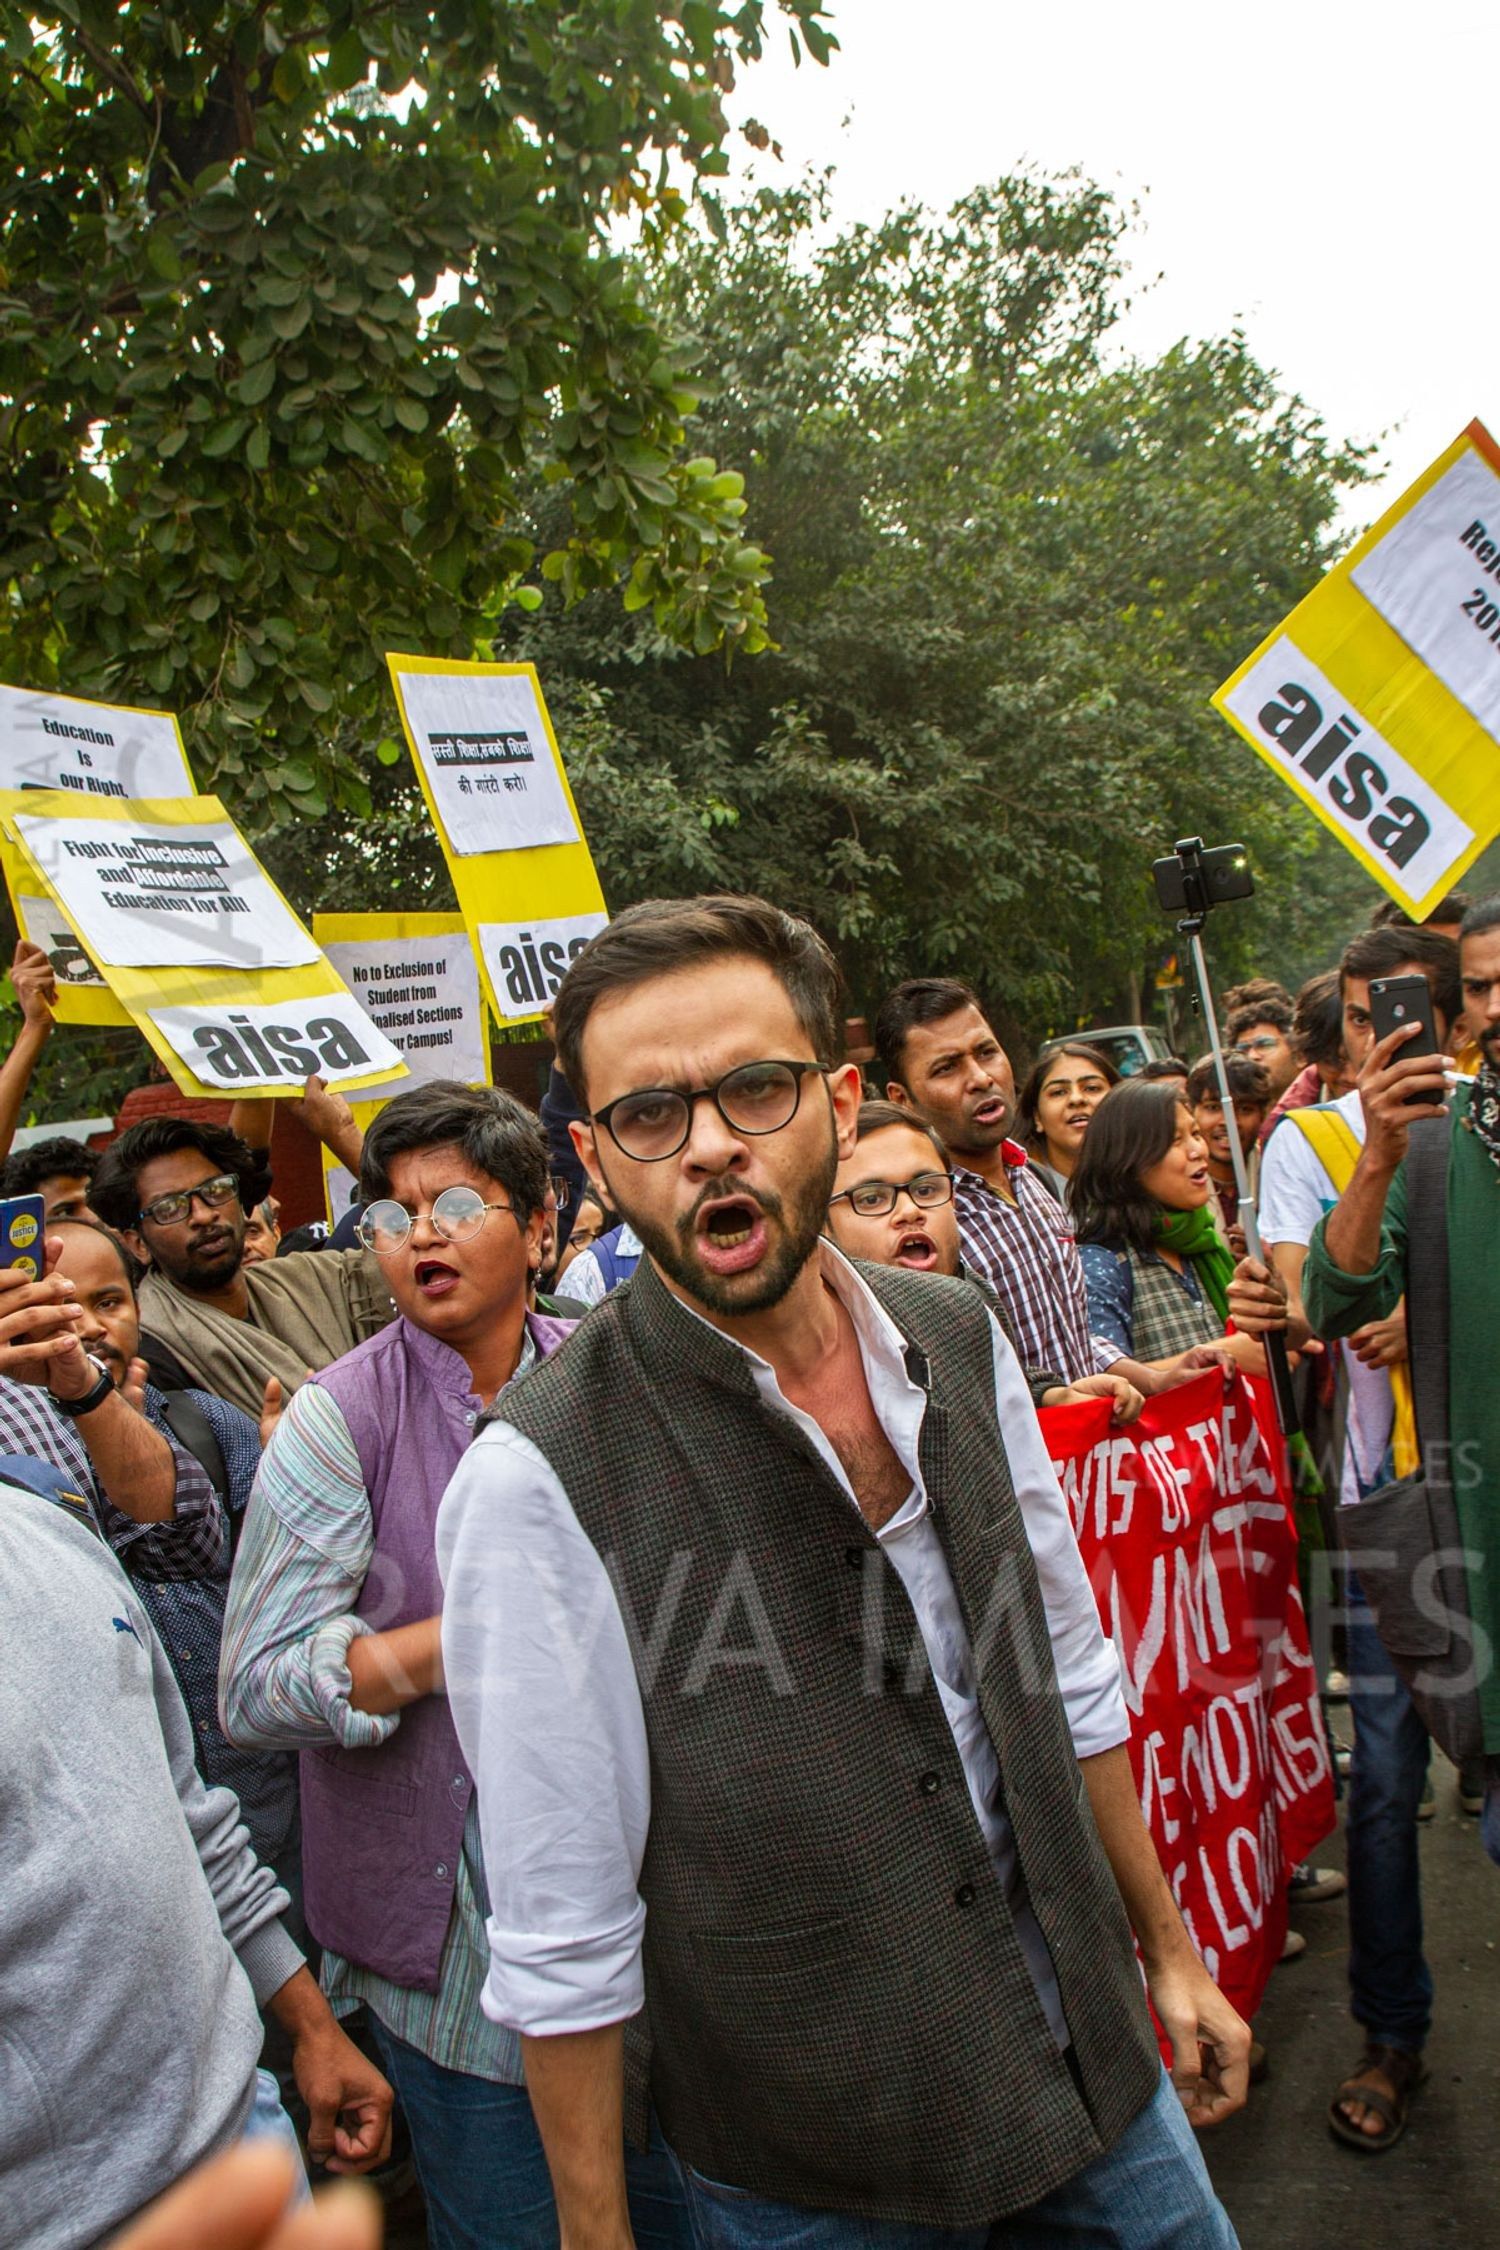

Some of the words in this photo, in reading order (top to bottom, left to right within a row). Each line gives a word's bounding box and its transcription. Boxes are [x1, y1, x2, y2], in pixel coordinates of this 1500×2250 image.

[1459, 519, 1500, 584] Rej
[1460, 588, 1500, 656] 201
[42, 718, 114, 747] Education
[78, 749, 93, 767] Is
[60, 773, 85, 790] our
[457, 774, 473, 794] की
[1258, 682, 1431, 870] aisa
[62, 840, 111, 860] Fight
[111, 841, 141, 860] for
[141, 843, 223, 864] Inclusive
[97, 867, 134, 883] and
[134, 868, 225, 890] Affordable
[101, 891, 194, 912] Education
[194, 893, 218, 912] for
[221, 896, 251, 913] All!
[352, 966, 368, 983] No
[370, 966, 382, 981] to
[383, 961, 434, 980] Exclusion
[435, 959, 447, 975] of
[367, 986, 410, 1006] Student
[411, 985, 437, 1001] from
[417, 1006, 463, 1024] Sections
[193, 1015, 371, 1078] aisa
[389, 1037, 405, 1051] ur
[406, 1028, 453, 1050] Campus!
[1050, 1437, 1138, 1541] NTS
[1140, 1435, 1191, 1533] OF
